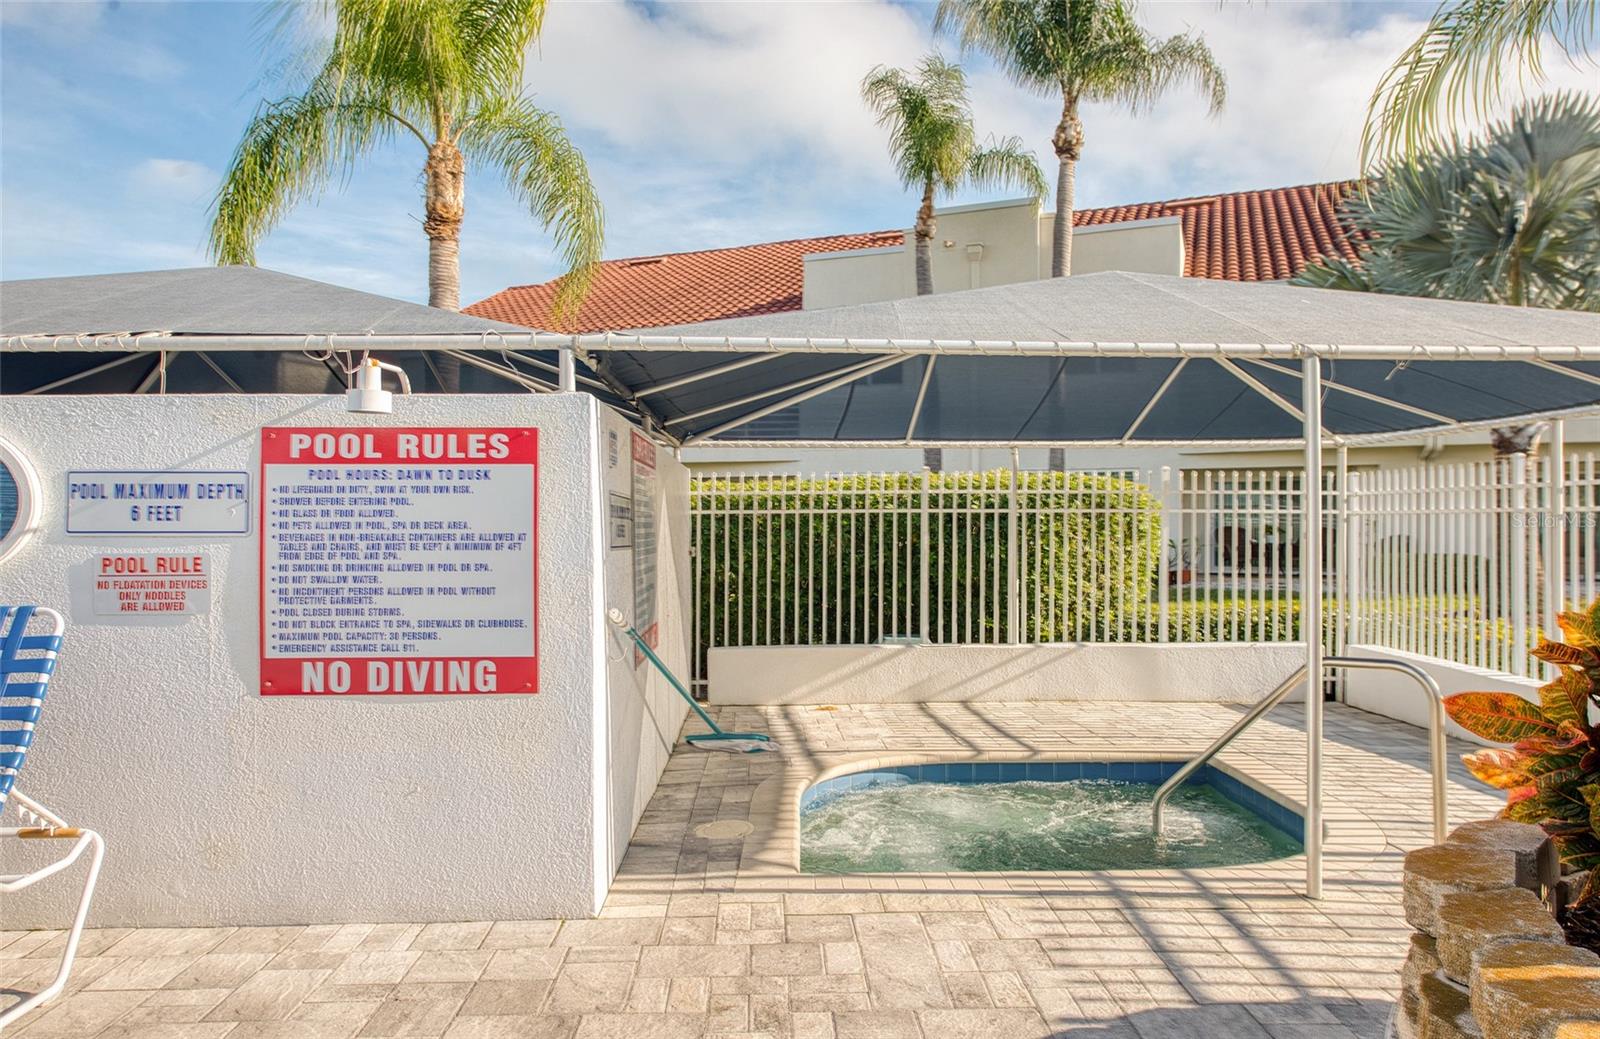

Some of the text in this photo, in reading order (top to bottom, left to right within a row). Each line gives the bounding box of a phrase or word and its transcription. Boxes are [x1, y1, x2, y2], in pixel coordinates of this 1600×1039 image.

[290, 433, 509, 459] POOL RULES
[309, 469, 490, 480] POOL HOURS: DAWN TO DUSK
[71, 483, 244, 500] POOL MAXIMUM DEPTH
[279, 486, 290, 495] NO
[292, 486, 333, 495] LIFEGUARD
[336, 486, 347, 495] ON
[374, 486, 395, 495] SWIM
[399, 486, 407, 495] AT
[411, 486, 430, 495] YOUR
[433, 486, 451, 495] OWN
[279, 498, 312, 506] SHOWER
[315, 498, 345, 506] BEFORE
[349, 498, 386, 506] ENTERING
[131, 506, 182, 522] 6 FEET
[279, 510, 289, 518] NO
[292, 510, 317, 518] GLASS
[320, 510, 330, 518] OR
[334, 510, 354, 518] FOOD
[279, 522, 290, 530] NO
[292, 522, 312, 530] PETS
[315, 522, 352, 530] ALLOWED
[355, 522, 362, 530] IN
[392, 522, 407, 530] SPA
[410, 522, 421, 530] OR
[423, 522, 443, 530] DECK
[279, 533, 527, 542] BEVERAGES IN NON-BREAKABLE CONTAINERS ARE ALLOWED AT
[279, 543, 308, 551] TABLES
[311, 543, 327, 551] AND
[366, 543, 381, 551] AND
[385, 543, 406, 551] MUST
[409, 543, 419, 551] BE
[423, 543, 442, 551] KEPT
[446, 543, 451, 551] A
[454, 543, 492, 551] MINIMUM
[495, 543, 504, 551] OF
[507, 543, 522, 551] 4FT
[279, 552, 302, 560] FROM
[304, 552, 324, 560] EDGE
[327, 552, 337, 560] OF
[340, 552, 360, 560] POOL
[364, 552, 379, 560] AND
[102, 557, 201, 573] POOL RULE
[279, 564, 290, 572] NO
[292, 564, 328, 572] SMOKING
[332, 564, 343, 572] OR
[345, 564, 384, 572] DRINKING
[387, 564, 424, 572] ALLOWED
[427, 564, 435, 572] IN
[437, 564, 457, 572] POOL
[461, 564, 472, 572] OR
[97, 580, 207, 589] NO FLOATATION DEVICES
[278, 576, 290, 584] DO
[292, 576, 307, 584] NOT
[310, 576, 348, 584] SWALLOW
[119, 592, 186, 600] ONLY NOODLES
[278, 587, 496, 596] NO INCONTINENT PERSONS ALLOWED IN POOL WITHOUT
[278, 596, 327, 605] PROTECTIVE
[121, 602, 185, 611] ARE ALLOWED
[279, 608, 299, 616] POOL
[302, 608, 333, 616] CLOSED
[335, 608, 365, 616] DURING
[278, 620, 289, 629] DO
[292, 620, 307, 629] NOT
[310, 620, 336, 629] BLOCK
[339, 620, 380, 629] ENTRANCE
[383, 620, 394, 629] TO
[417, 620, 462, 629] SIDEWALKS
[464, 620, 476, 629] OR
[279, 632, 320, 641] MAXIMUM
[322, 632, 342, 641] POOL
[346, 632, 387, 641] CAPACITY:
[279, 644, 326, 653] EMERGENCY
[330, 644, 378, 653] ASSISTANCE
[381, 644, 399, 653] CALL
[302, 660, 497, 693] NO DIVING
